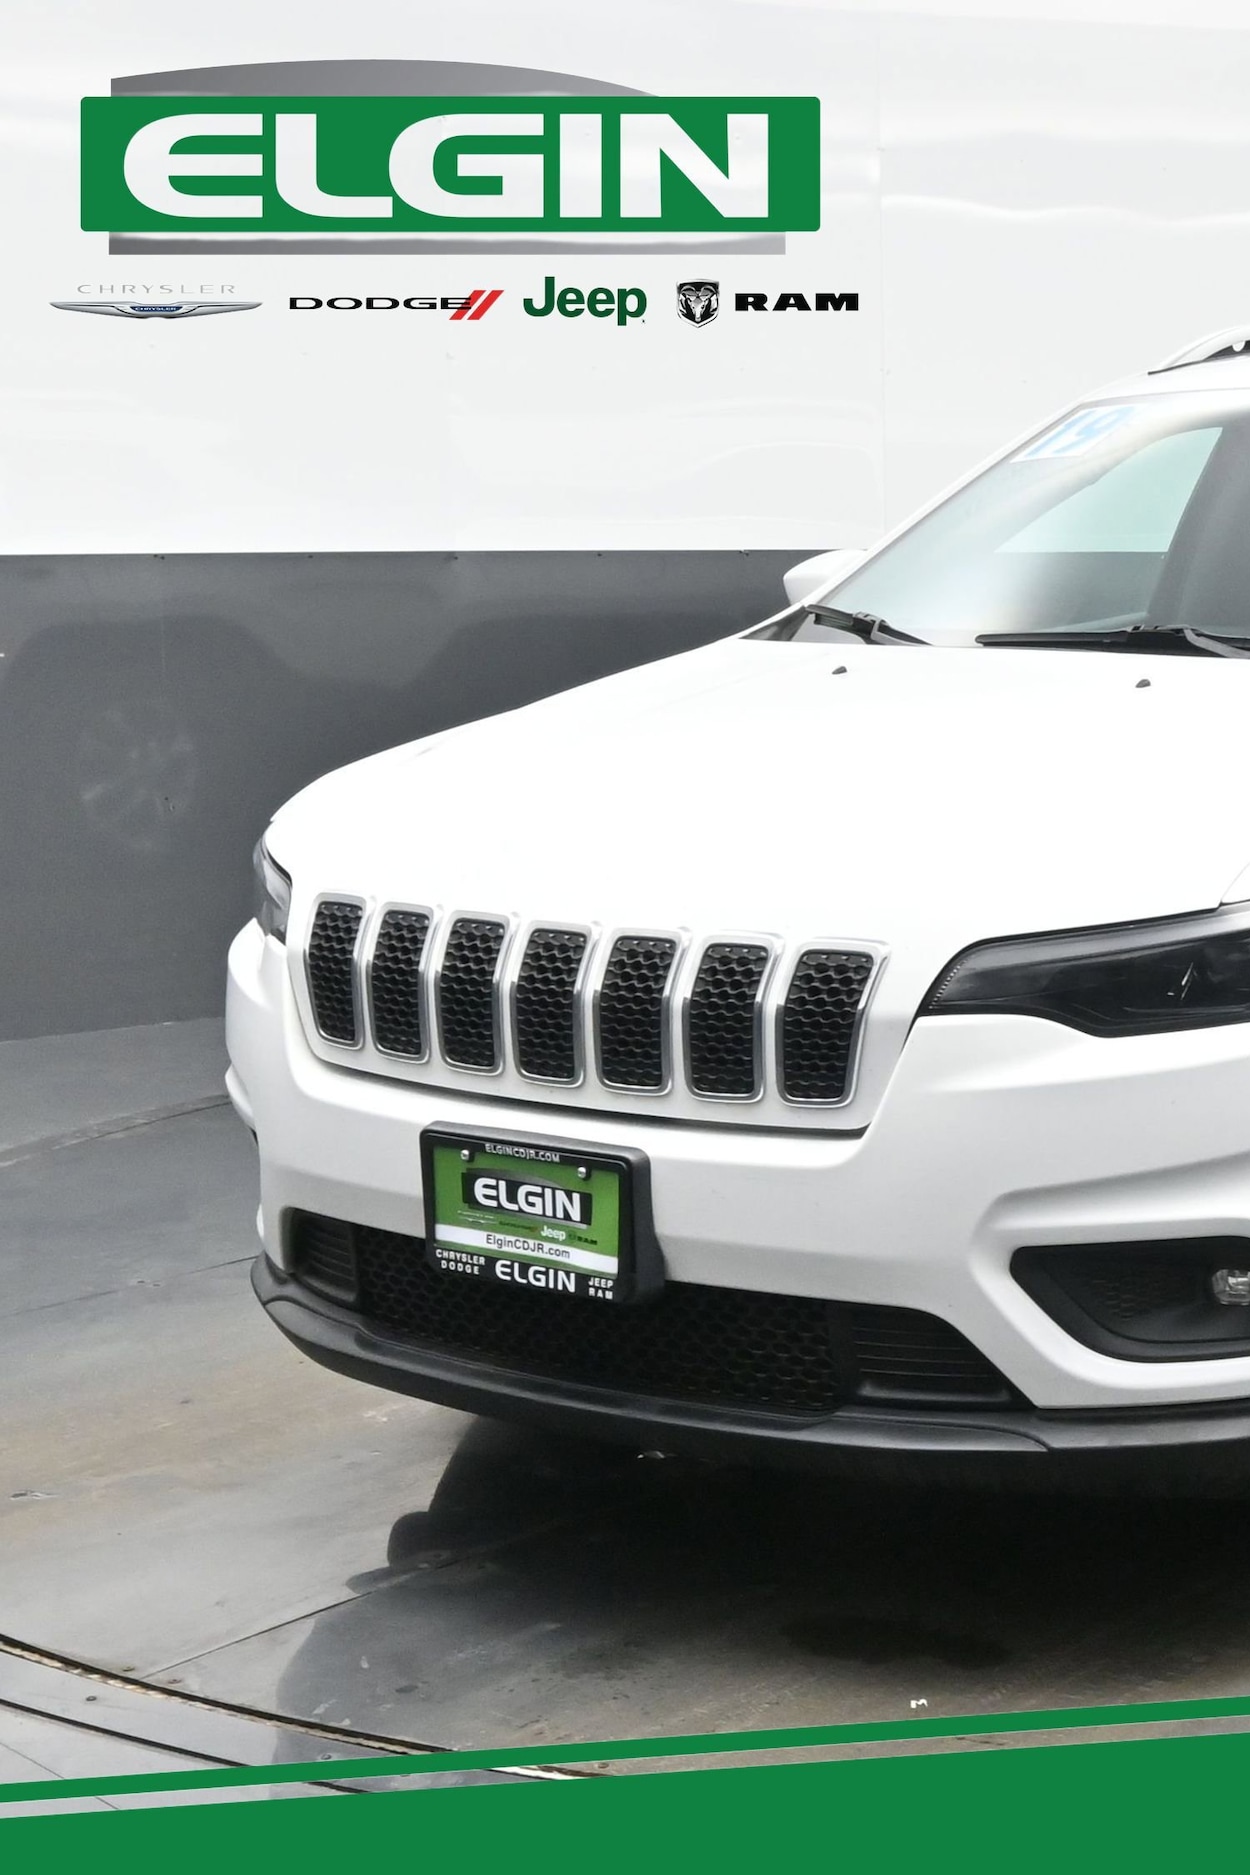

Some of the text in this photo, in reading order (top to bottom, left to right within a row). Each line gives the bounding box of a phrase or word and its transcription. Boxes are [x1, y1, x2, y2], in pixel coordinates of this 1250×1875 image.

[485, 1143, 560, 1163] ELGINCDJR.COM
[473, 1177, 581, 1221] ELGIN
[540, 1225, 566, 1241] Jeep
[486, 1234, 571, 1259] ElginCDJR.com
[435, 1248, 486, 1266] CHRYSLER
[441, 1260, 480, 1275] DODGE
[495, 1260, 576, 1293] ELGIN
[588, 1277, 614, 1289] JEEP
[588, 1288, 613, 1300] RAM
